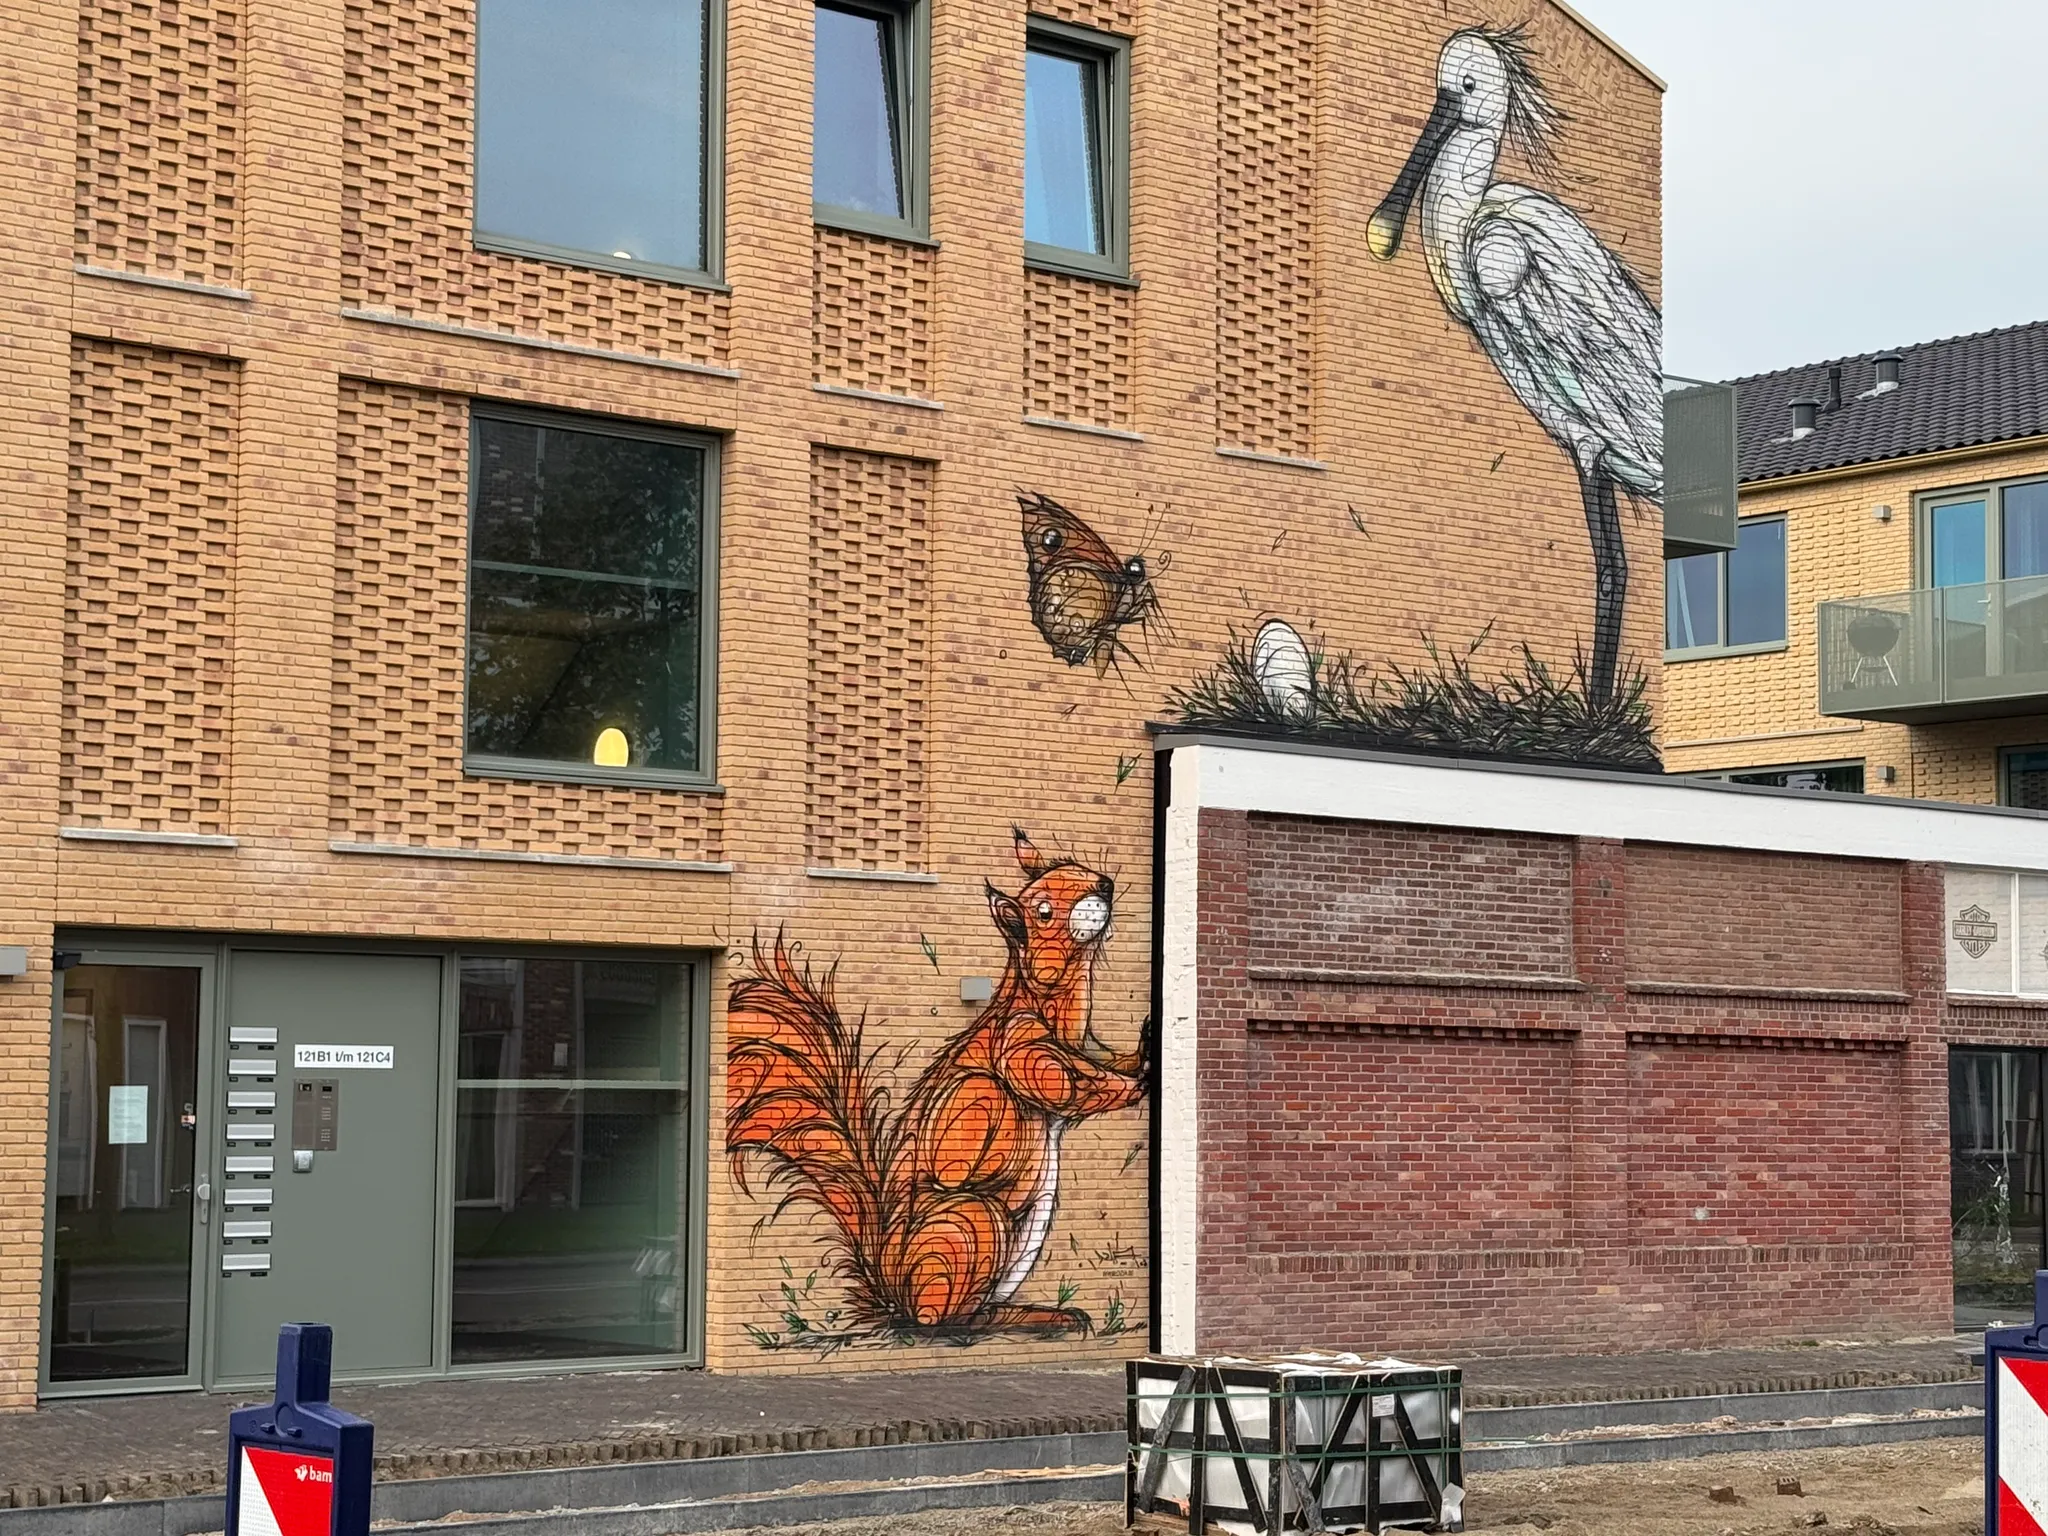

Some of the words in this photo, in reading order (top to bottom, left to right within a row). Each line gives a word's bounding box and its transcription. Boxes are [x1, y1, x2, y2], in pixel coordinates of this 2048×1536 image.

[298, 1050, 331, 1062] 121B1
[335, 1050, 354, 1063] t/m
[357, 1051, 390, 1063] 121C4
[309, 1464, 333, 1483] bam
